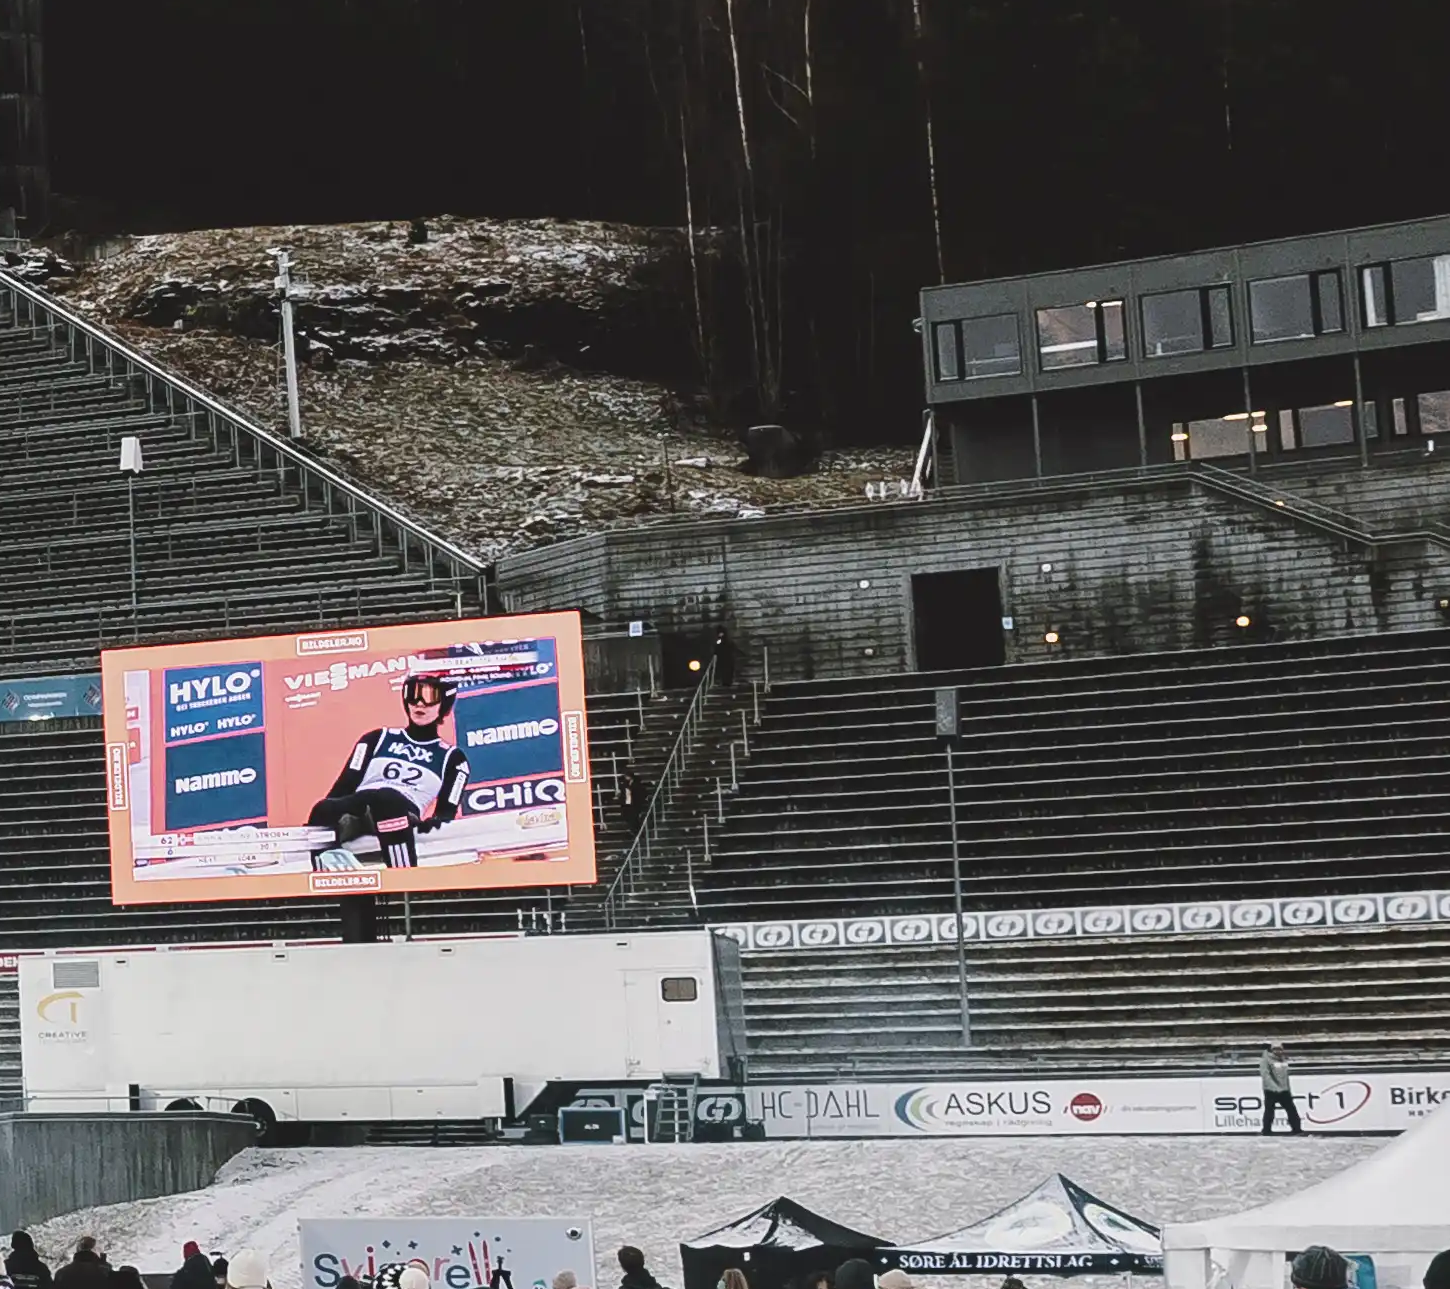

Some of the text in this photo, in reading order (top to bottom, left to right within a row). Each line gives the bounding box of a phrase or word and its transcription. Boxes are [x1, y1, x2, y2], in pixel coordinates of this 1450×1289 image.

[170, 671, 252, 705] HYLO
[171, 715, 251, 737] HYLO HYLO
[383, 762, 423, 786] 62
[38, 1031, 87, 1039] CREATIVE
[944, 1091, 1051, 1115] ASKUS
[1215, 1092, 1320, 1115] spt
[899, 1254, 946, 1269] SØRE
